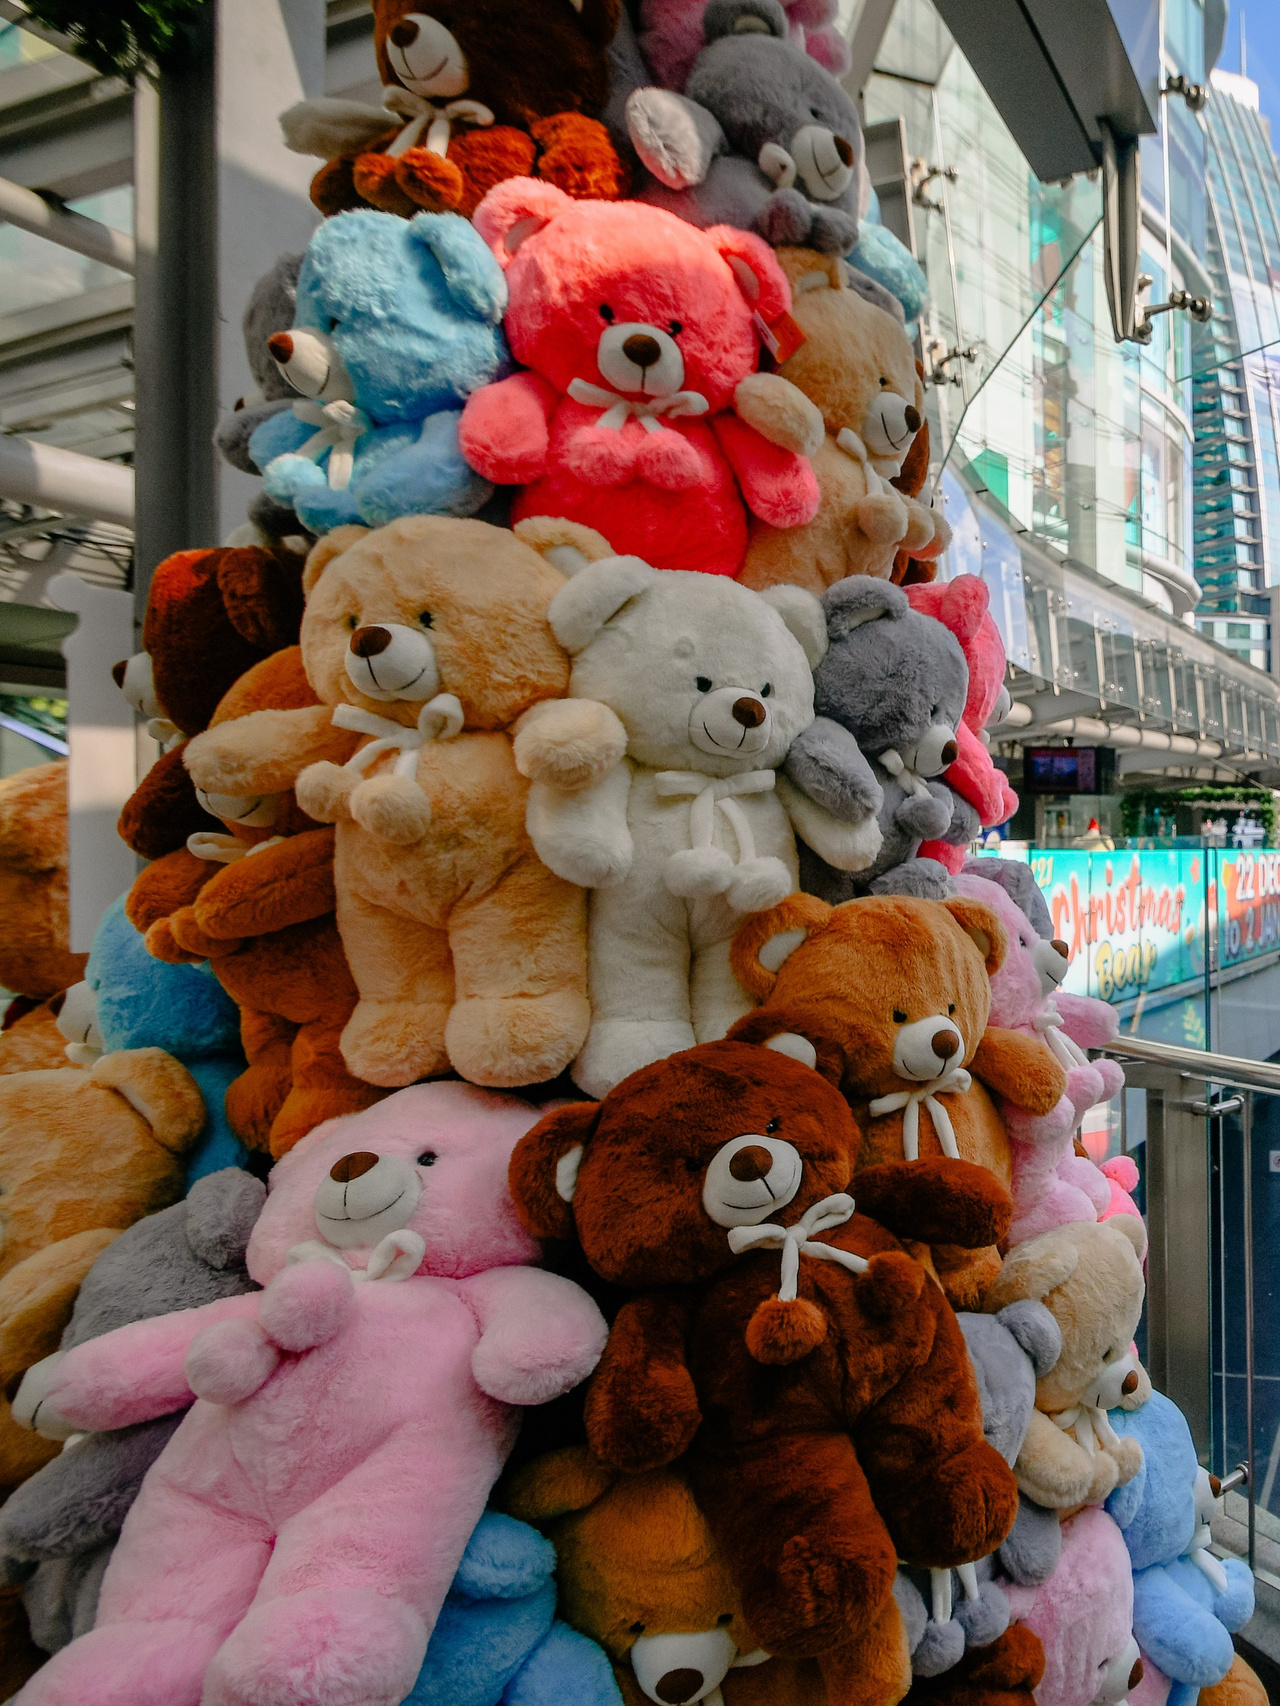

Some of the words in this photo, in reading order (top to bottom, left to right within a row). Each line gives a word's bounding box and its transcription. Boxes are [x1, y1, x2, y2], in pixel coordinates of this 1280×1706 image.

[1236, 853, 1255, 901] 22
[1051, 853, 1185, 965] Christmas
[1246, 905, 1255, 953] 2
